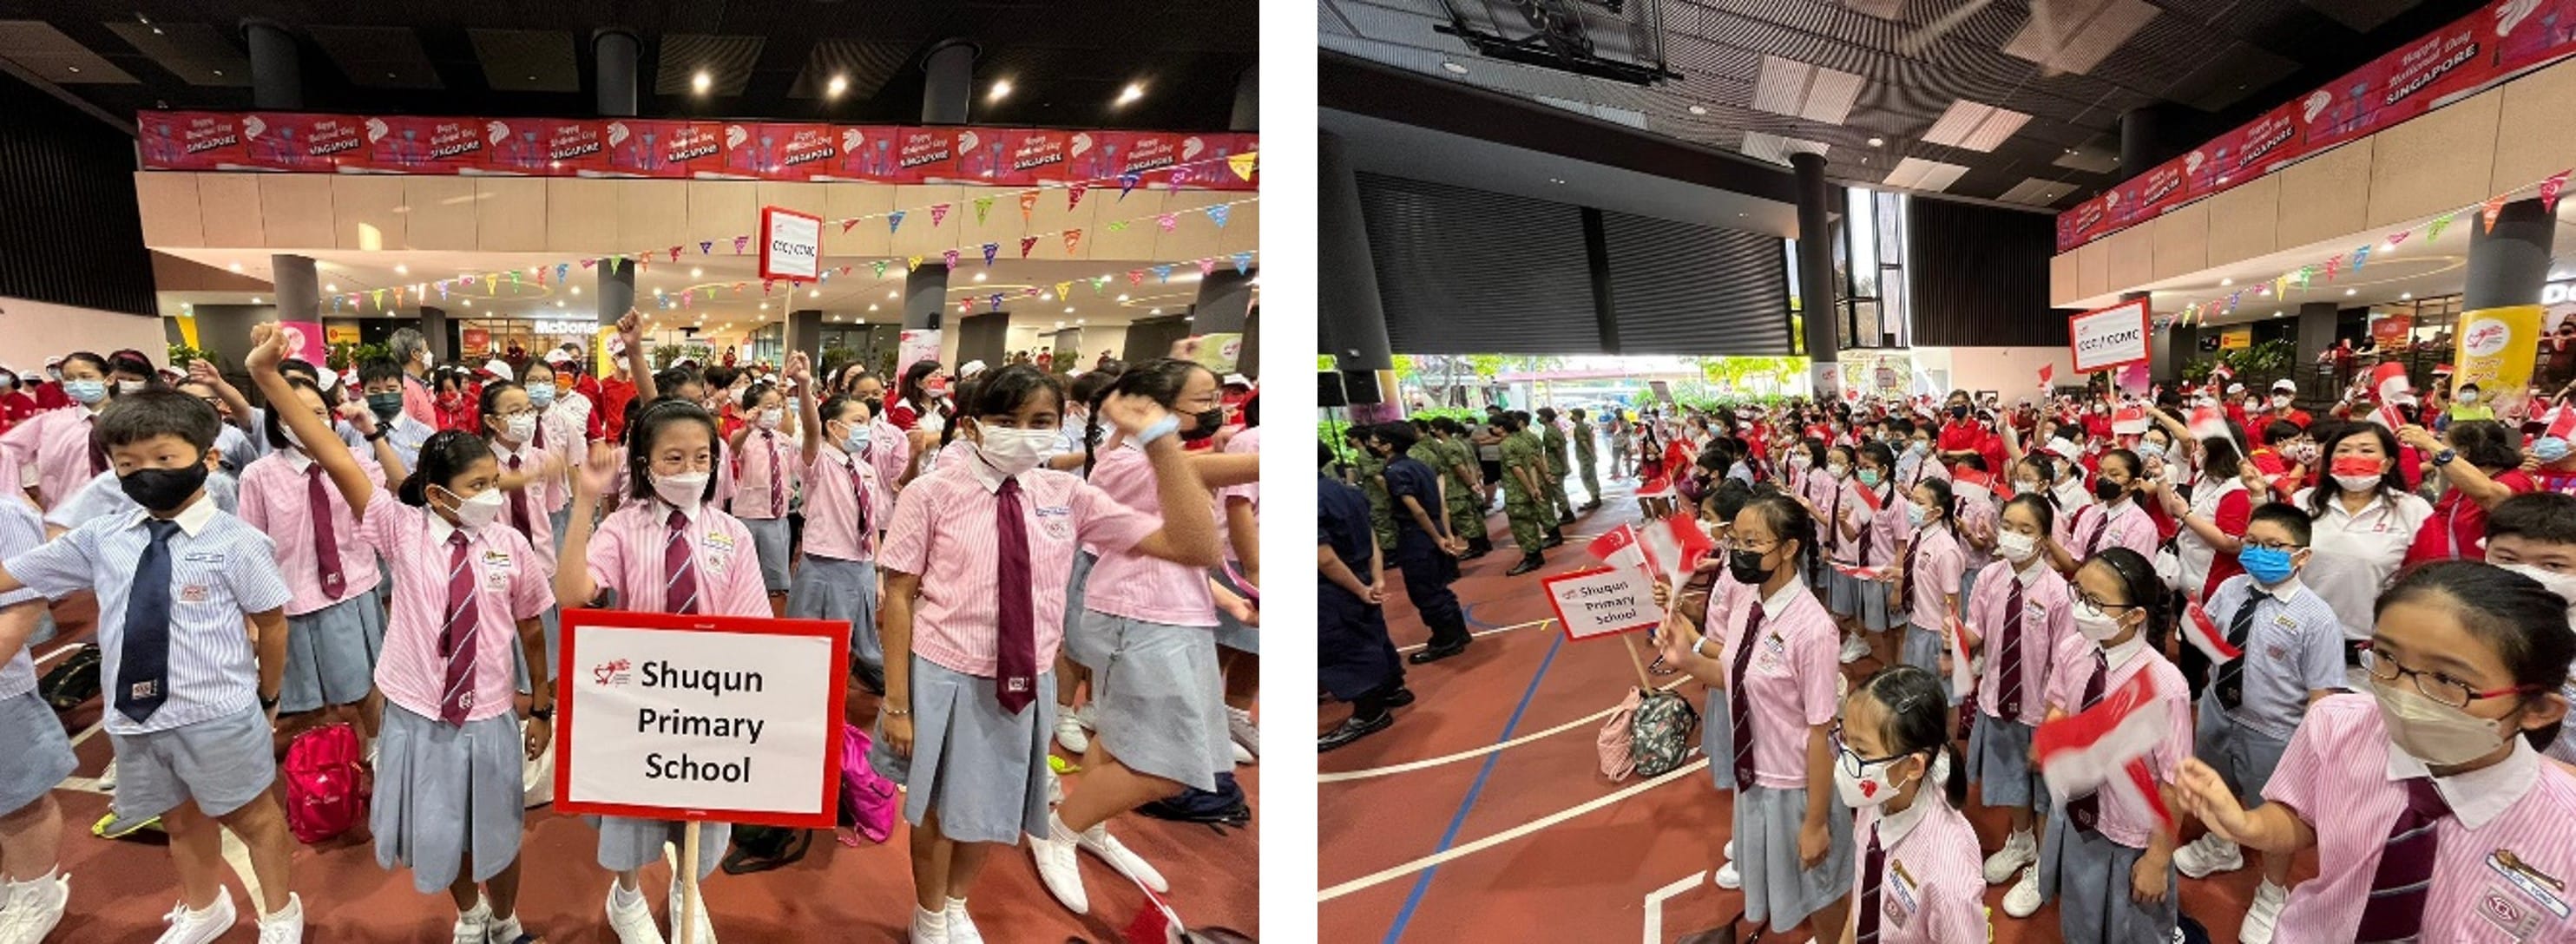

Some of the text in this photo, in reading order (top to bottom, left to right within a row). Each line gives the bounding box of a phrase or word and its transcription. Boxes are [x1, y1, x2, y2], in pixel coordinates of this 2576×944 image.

[2389, 30, 2471, 88] National Day
[2402, 36, 2440, 66] Happy
[2387, 43, 2475, 104] SINGAPORE
[1580, 581, 1629, 597] Shuqun
[1585, 595, 1635, 611] Primary
[1596, 608, 1637, 625] School
[641, 660, 763, 697] Shuqun
[638, 708, 764, 744] Primary
[645, 752, 751, 783] School
